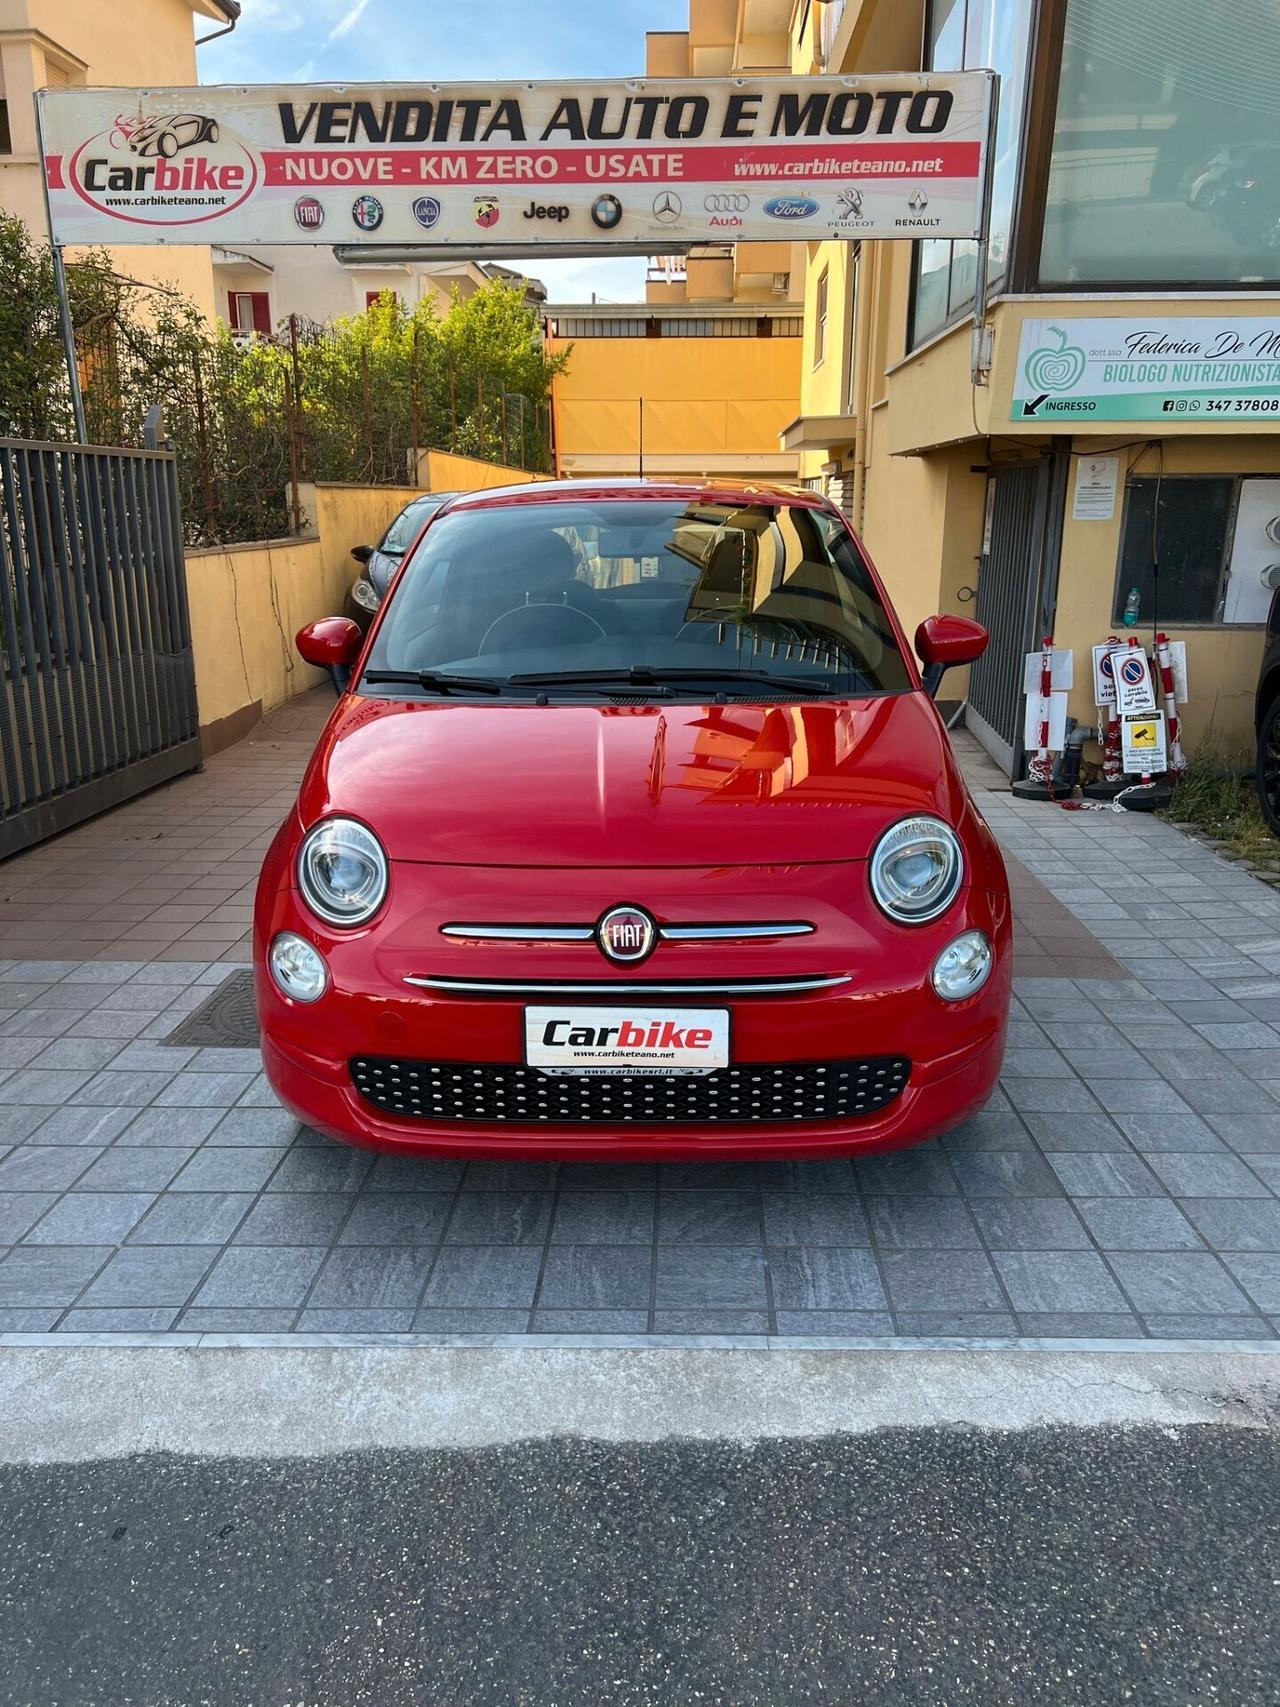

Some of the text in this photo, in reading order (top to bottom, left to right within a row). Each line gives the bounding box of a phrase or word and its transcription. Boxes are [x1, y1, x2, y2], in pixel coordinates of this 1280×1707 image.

[278, 90, 954, 143] VENDITA AUTO E MOTO
[84, 158, 245, 192] Carbike
[285, 156, 393, 181] NUOVE
[420, 156, 470, 180] KM
[476, 154, 561, 179] ZERO
[586, 153, 684, 178] USATE
[734, 157, 944, 176] www.carbiketeano.net
[105, 195, 226, 206] www.carbiketeano.net
[774, 200, 809, 216] Ford
[300, 206, 319, 223] FIAT
[523, 202, 570, 222] Jeep
[709, 215, 743, 227] Audi
[827, 220, 876, 228] PEUGEOT
[895, 218, 941, 227] RENAULT
[1089, 348, 1122, 357] dott.ssa
[1124, 331, 1202, 359] Federica
[1204, 331, 1245, 359] De
[1103, 362, 1280, 383] BIOLOGO NUTRIZIONISTA
[1045, 402, 1097, 411] INGRESSO
[1206, 400, 1279, 412] 347 37808
[612, 924, 643, 947] FIAT
[542, 1020, 713, 1049] Carbike
[573, 1049, 675, 1059] www.carbiketeano.net
